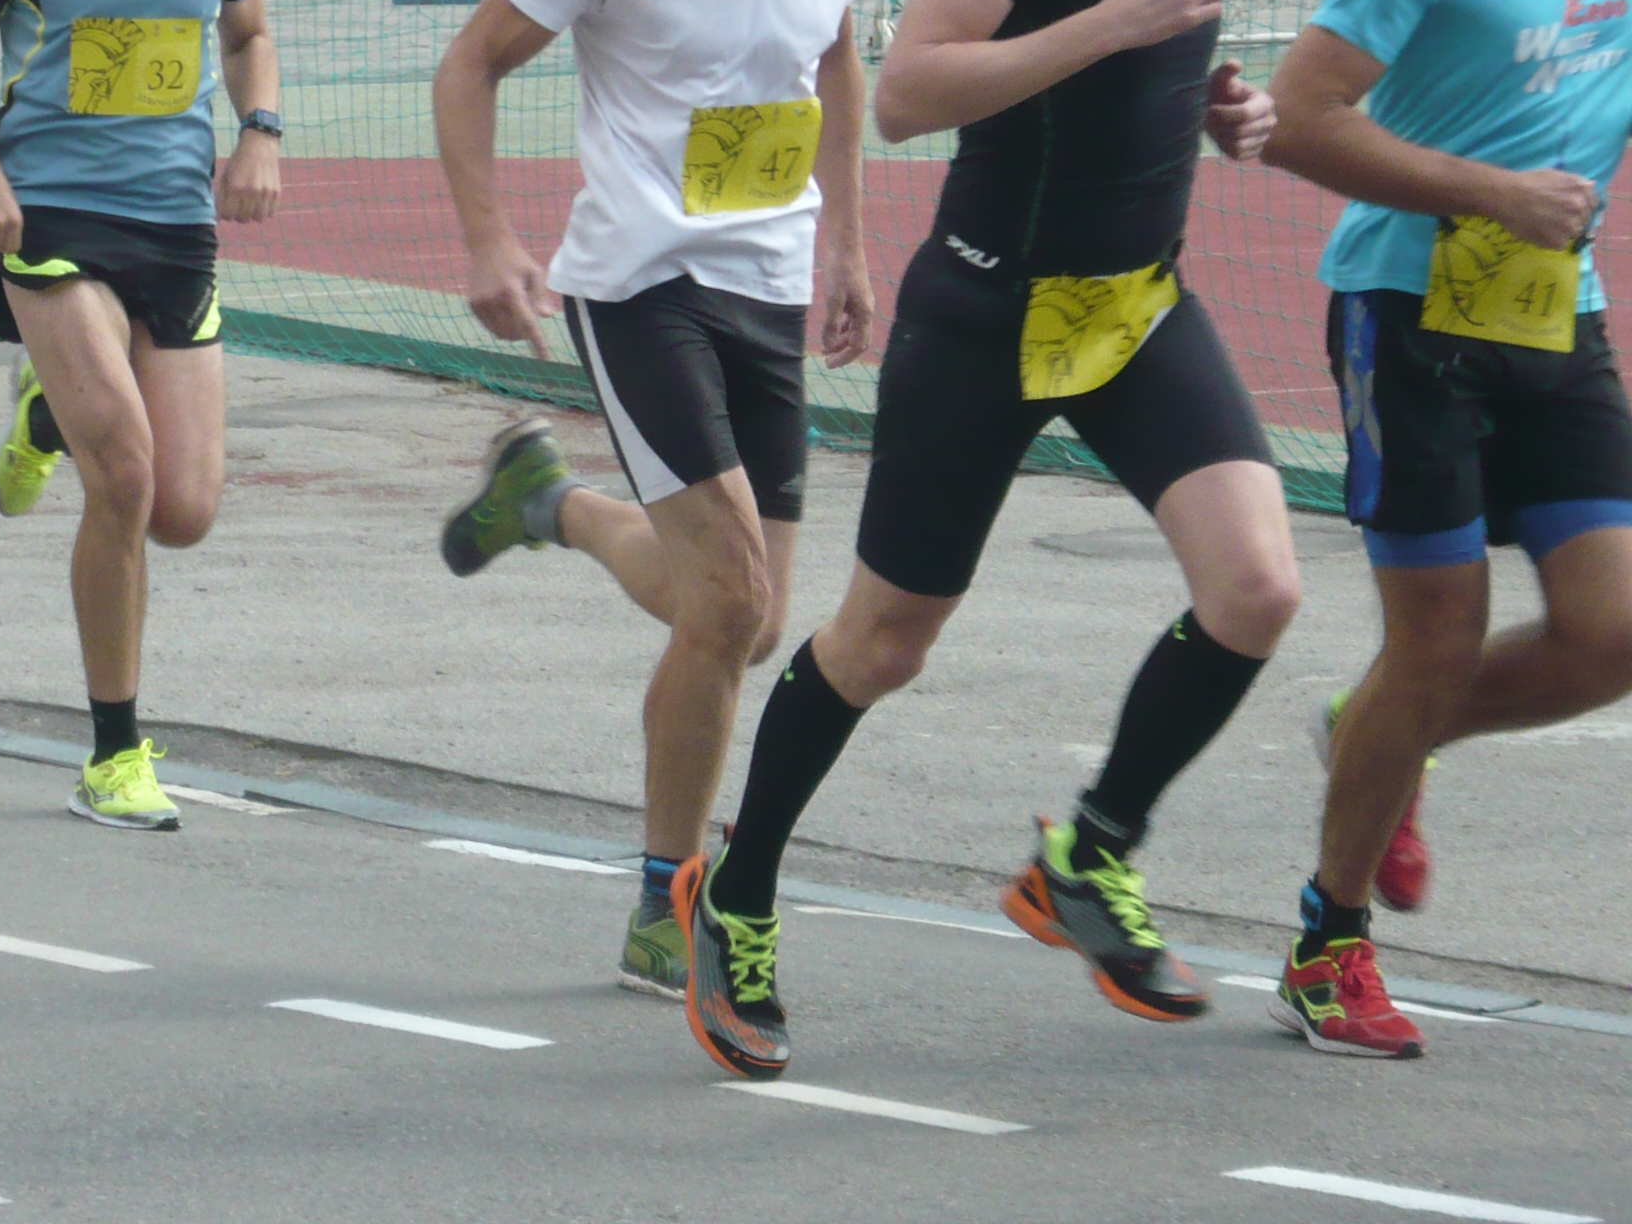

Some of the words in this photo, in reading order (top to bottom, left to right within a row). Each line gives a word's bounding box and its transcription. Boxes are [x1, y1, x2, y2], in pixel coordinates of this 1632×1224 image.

[147, 59, 186, 91] 32
[759, 145, 802, 182] 47
[1513, 279, 1558, 317] 41
